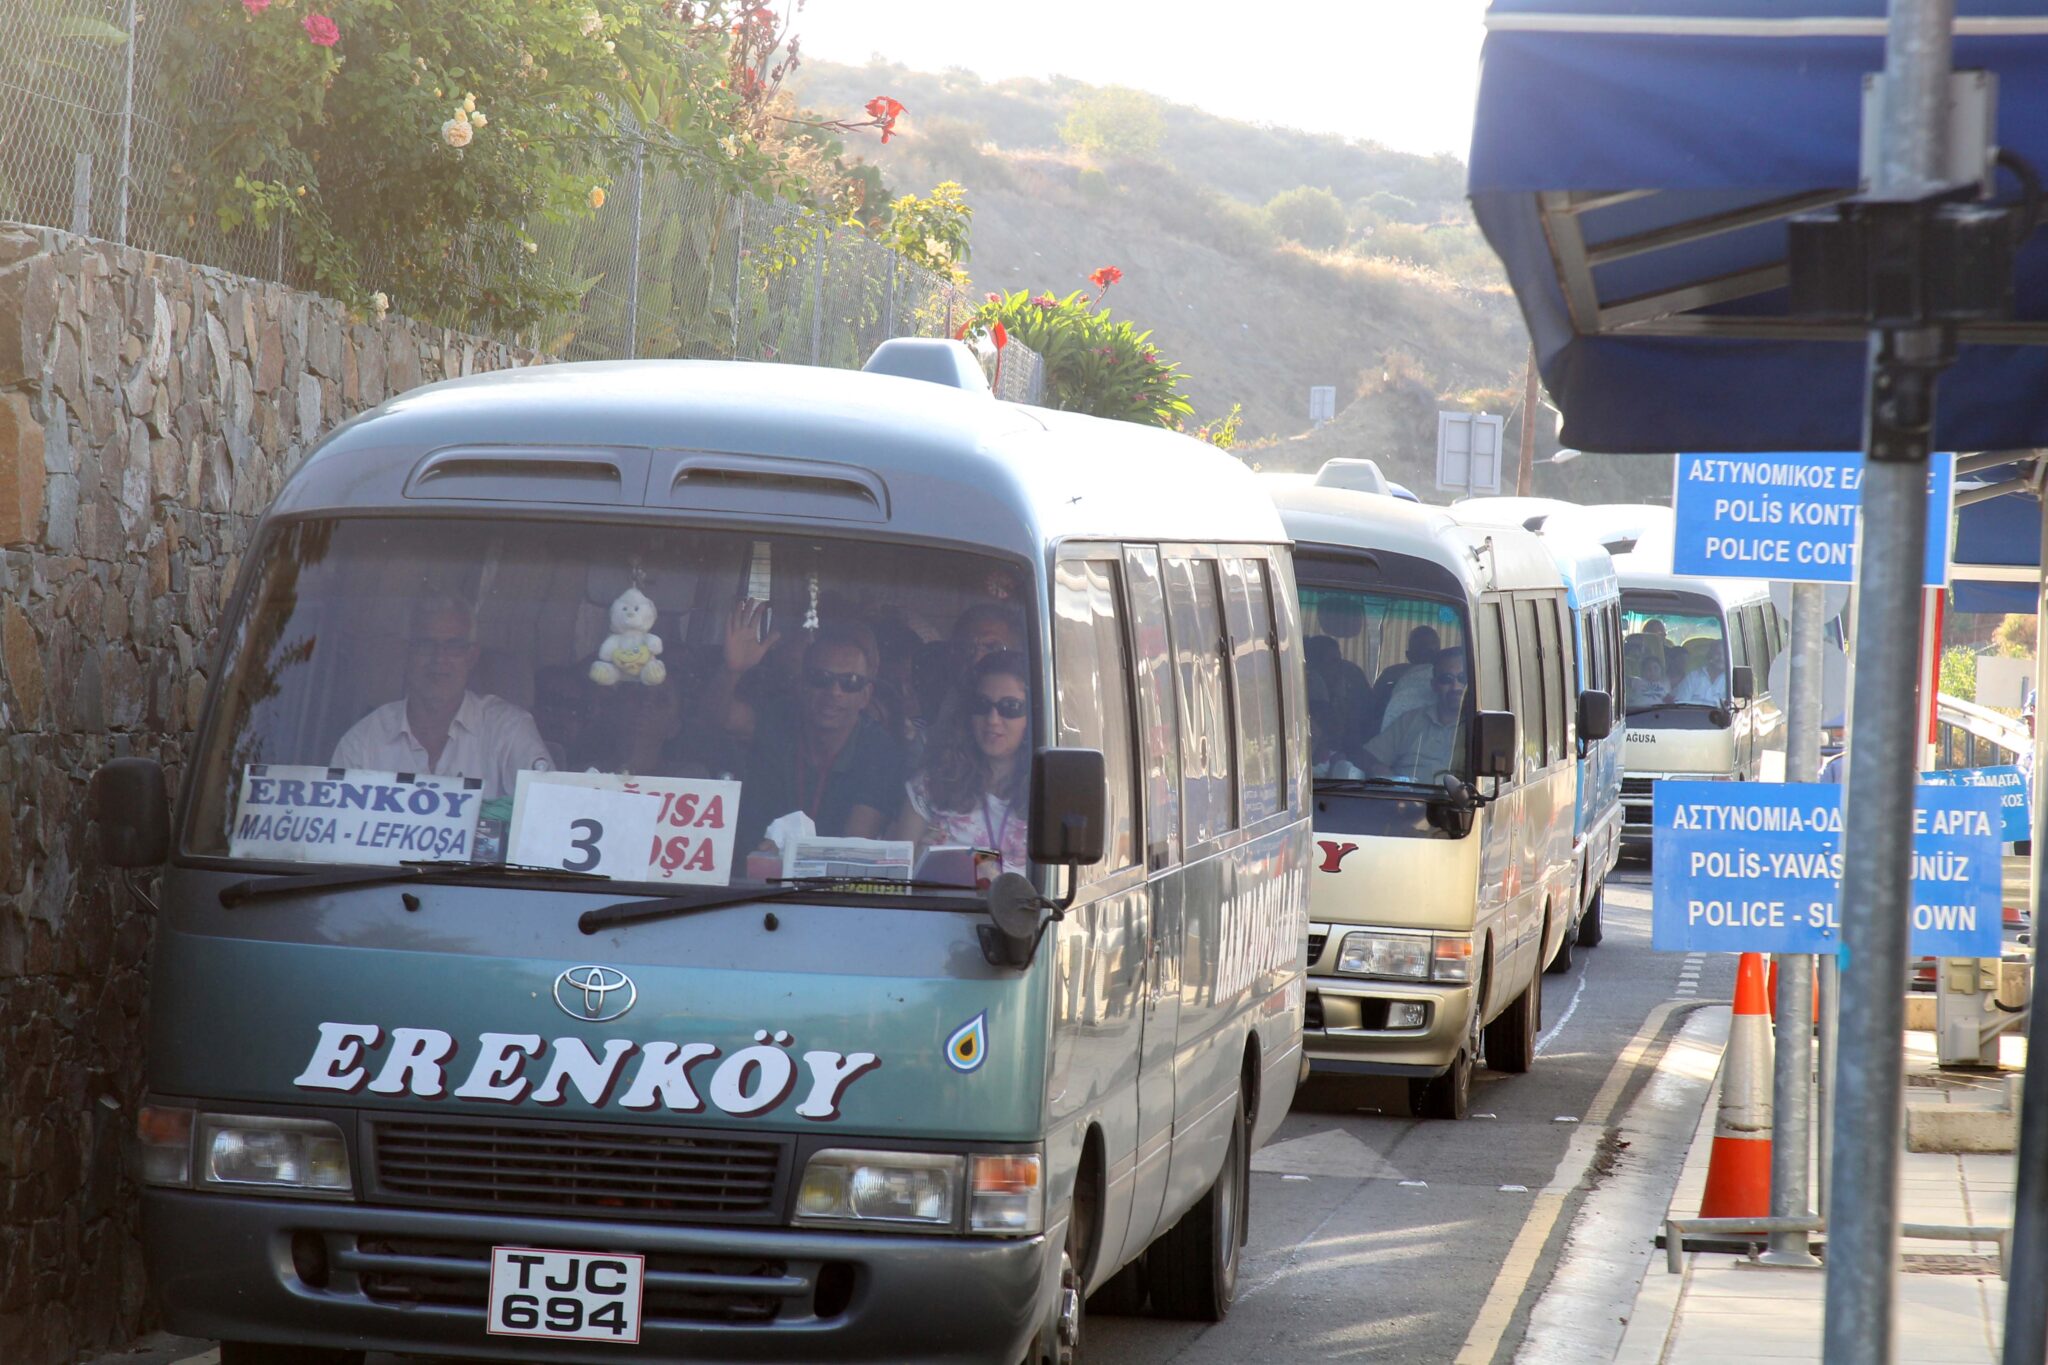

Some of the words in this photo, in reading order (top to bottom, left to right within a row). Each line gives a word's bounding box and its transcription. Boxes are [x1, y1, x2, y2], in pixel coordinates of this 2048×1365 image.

[1688, 459, 1836, 489] ΑΣΤΥΝΟΜΙΚΟΣ
[1789, 503, 1855, 527] KONT
[1705, 536, 1790, 563] POLICE
[1797, 541, 1858, 566] CONT
[1625, 731, 1657, 744] AĞUSA
[246, 779, 473, 818] ERENKÖY
[237, 810, 337, 844] MAĞUSA
[355, 820, 468, 859] LEFKOŞA
[1931, 809, 1993, 837] ΑΡΓΑ
[562, 818, 604, 872] 3
[1688, 900, 1785, 928] POLICE
[1808, 901, 1841, 929] SL
[1912, 904, 1977, 932] OWN
[293, 1022, 882, 1121] ERENKÖY
[508, 1254, 628, 1296] TJC
[500, 1295, 628, 1336] 694
